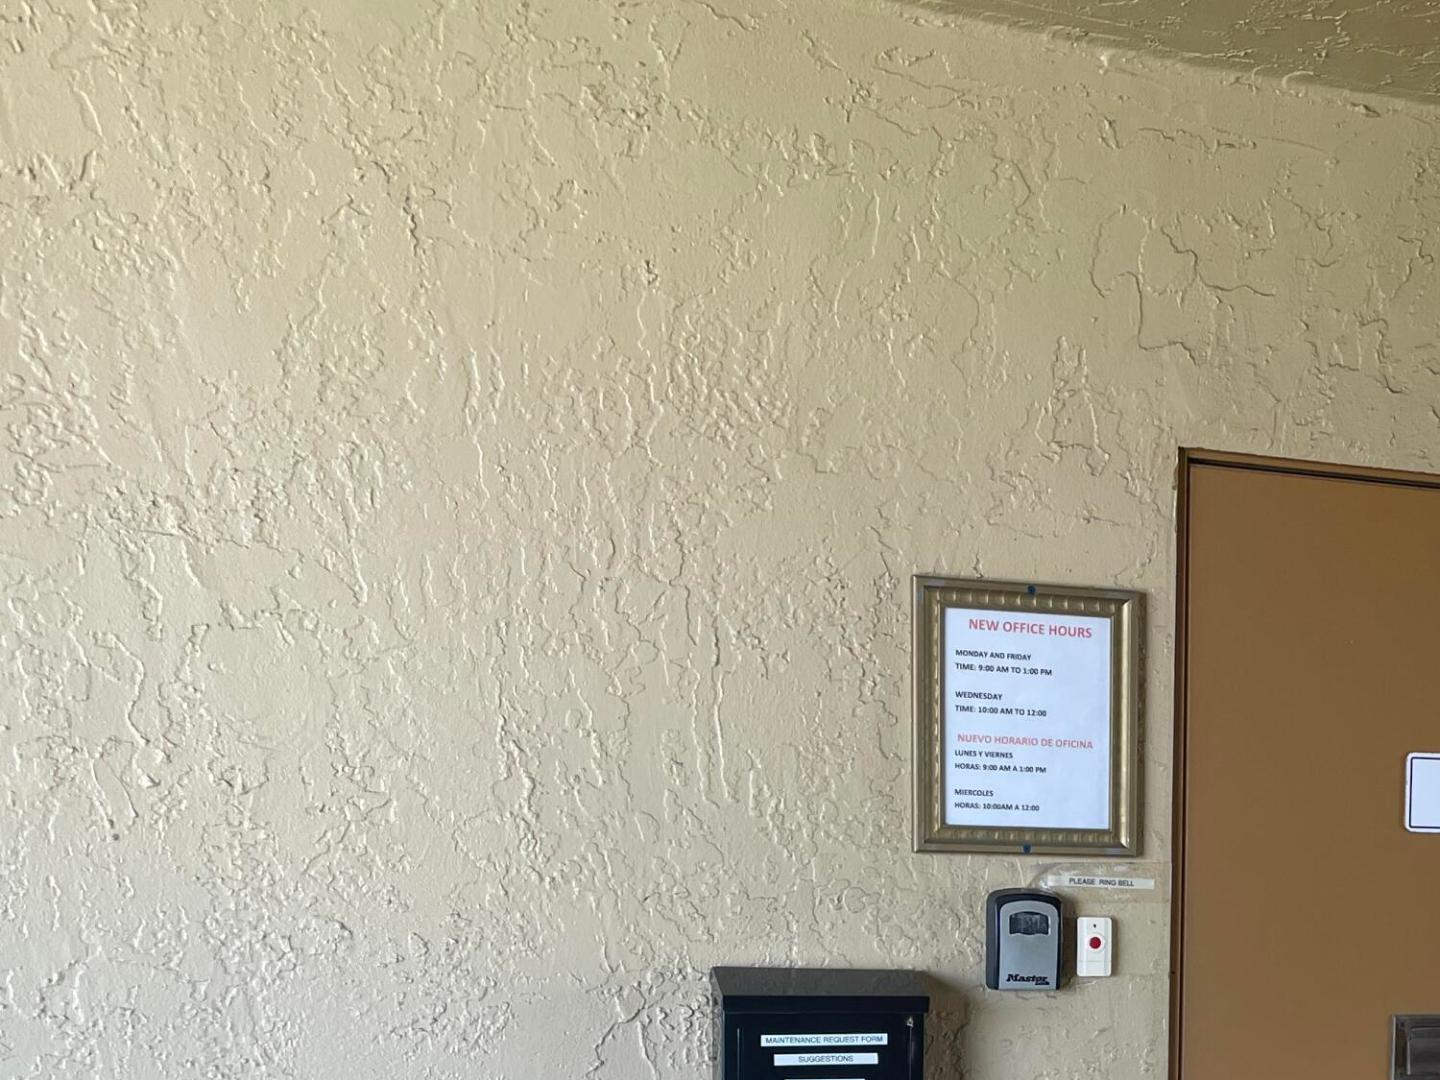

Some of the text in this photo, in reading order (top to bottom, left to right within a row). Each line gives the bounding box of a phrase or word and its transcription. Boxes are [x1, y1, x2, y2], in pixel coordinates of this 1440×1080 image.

[968, 618, 1093, 639] NEW OFFICE HOURS
[955, 649, 1032, 661] MONDAY AND FRIDAY
[955, 662, 977, 671] TIME:
[978, 664, 995, 673] 9:00
[995, 665, 1009, 674] AM
[1023, 667, 1039, 676] 1:00
[1039, 668, 1053, 677] PM
[955, 691, 1003, 701] WEDNESDAY
[955, 704, 1047, 717] TIME: 10:00 AM TO 12:00
[957, 733, 1094, 750] NUEVO HORARIO DE OFICINA
[954, 749, 977, 758] LUNES
[984, 751, 1014, 759] VIERNES
[954, 763, 981, 771] HORAS:
[982, 764, 998, 772] 9:00
[998, 765, 1011, 773] AM
[1019, 766, 1034, 774] 1:00
[954, 788, 994, 797] MIERCOLES
[954, 802, 980, 810] HORAS:
[1021, 804, 1040, 812] 12:00
[1006, 973, 1048, 983] Master
[765, 1035, 884, 1044] MAINTENANCE REQUEST FORM
[798, 1054, 854, 1063] SUGGESTIONS
